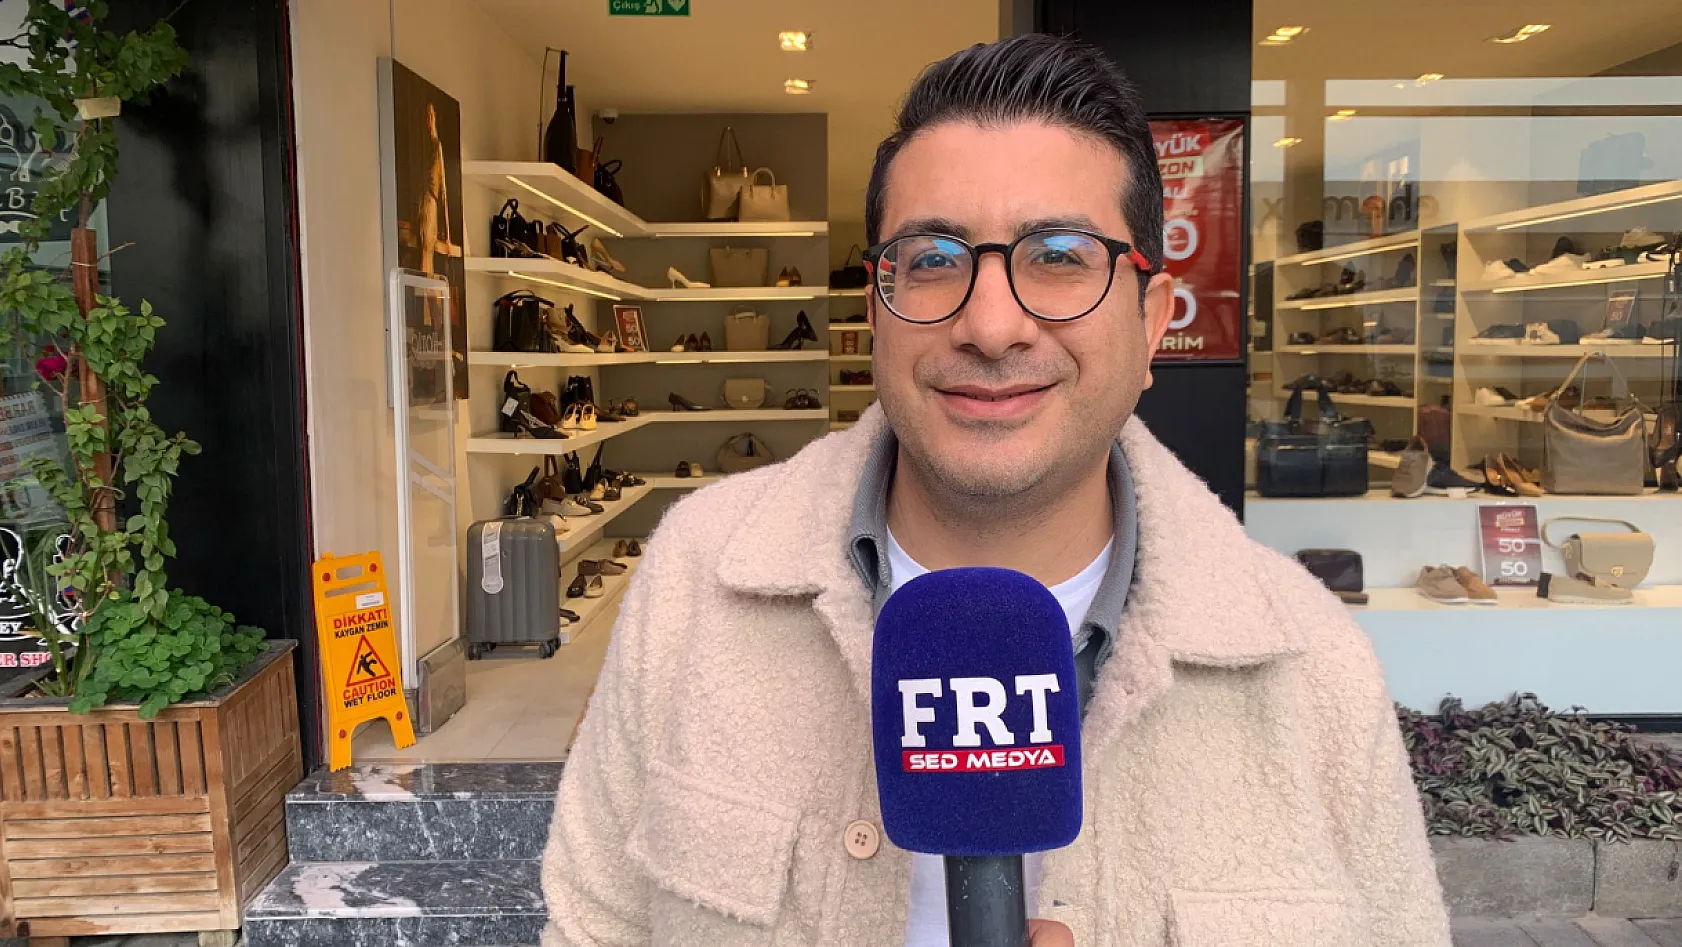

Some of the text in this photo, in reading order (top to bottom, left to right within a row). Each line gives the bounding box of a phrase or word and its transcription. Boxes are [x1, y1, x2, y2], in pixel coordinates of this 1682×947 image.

[1499, 538, 1526, 553] 50
[1501, 561, 1528, 577] 50
[335, 625, 365, 639] KAYGAN
[343, 677, 396, 700] CAUTION
[344, 688, 397, 708] WET FLOOR
[898, 674, 1061, 748] FRT
[909, 749, 1056, 770] SED MEDYA
